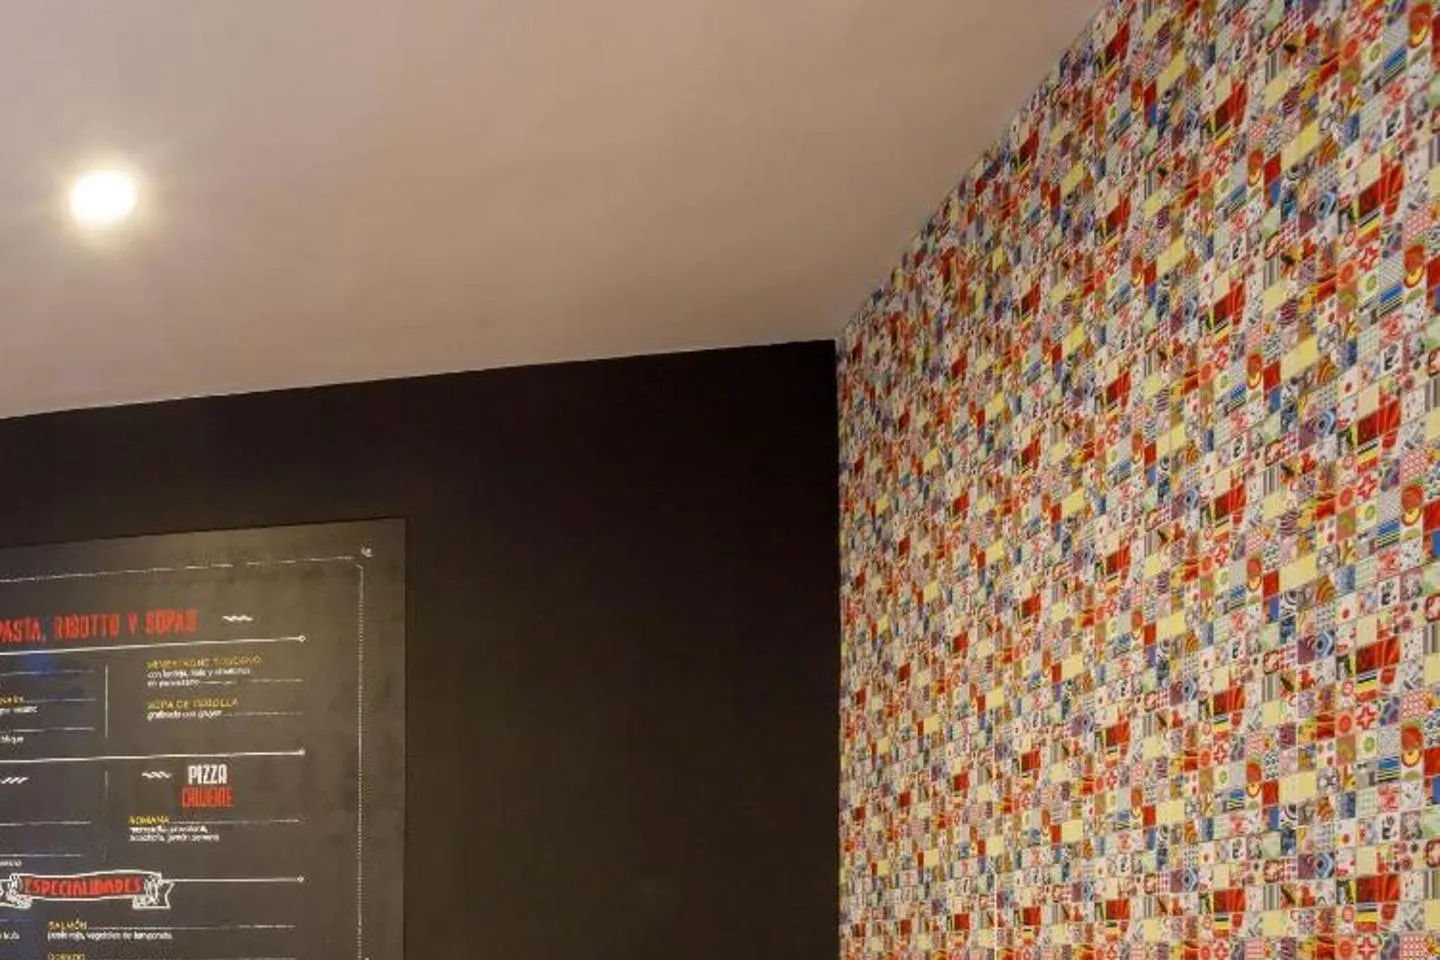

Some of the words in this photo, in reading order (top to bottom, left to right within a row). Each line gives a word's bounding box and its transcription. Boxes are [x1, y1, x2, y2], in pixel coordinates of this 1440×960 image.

[126, 612, 138, 635] Y
[187, 764, 227, 784] PIZZA
[24, 877, 142, 896] ESPECIALIDADES
